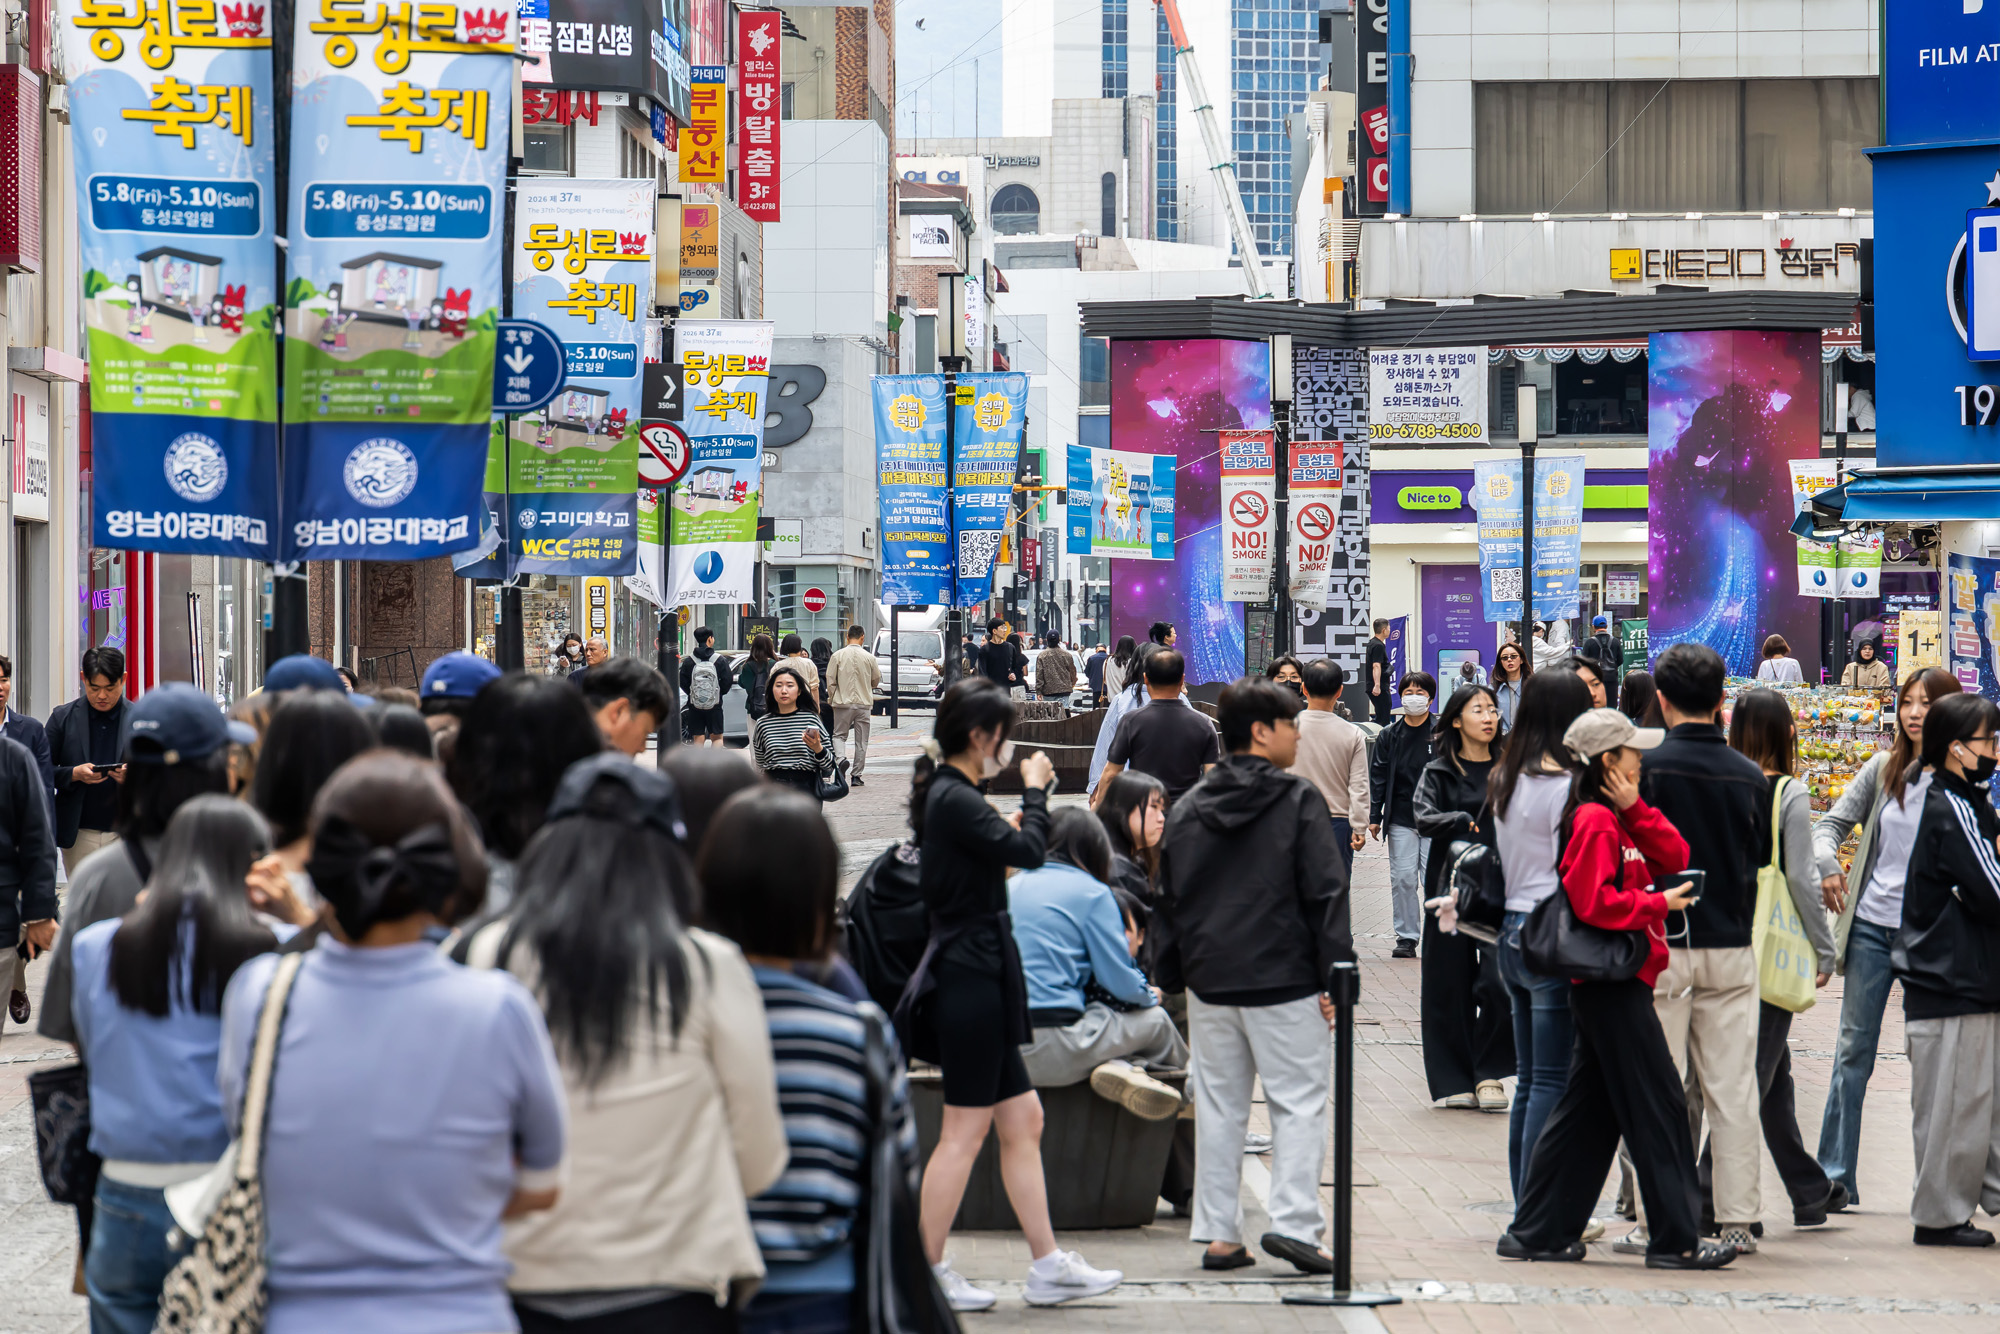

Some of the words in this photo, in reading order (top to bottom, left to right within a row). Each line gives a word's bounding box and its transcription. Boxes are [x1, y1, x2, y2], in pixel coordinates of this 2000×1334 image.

[556, 21, 593, 54] 점검
[597, 23, 633, 56] 신청
[1919, 46, 1968, 67] FILM
[745, 60, 775, 72] 앨리스
[690, 68, 724, 81] 카데미
[121, 75, 254, 149] 축제
[523, 90, 602, 126] 중개사
[346, 81, 490, 153] 축제
[687, 89, 721, 177] 부동산
[744, 83, 775, 177] 방탈출
[96, 181, 255, 210] 5.8(Fri)~5.10(Sun)
[749, 182, 771, 199] 3F
[312, 187, 486, 214] 5.8(Fri)~5.10(Sun)
[528, 195, 548, 203] 2026
[141, 209, 216, 229] 동성로일원
[355, 212, 437, 232] 동성로일원
[523, 223, 651, 274] 동성로
[680, 269, 716, 277] 25-0009
[547, 278, 637, 324] 축제
[697, 290, 706, 303] 2
[1371, 354, 1399, 365] 어려운
[1402, 354, 1422, 365] 경기
[1425, 354, 1435, 365] 속
[1438, 353, 1476, 365] 부담없이
[683, 350, 770, 387] 동성로
[1386, 368, 1426, 379] 장사하실
[1428, 368, 1438, 379] 수
[1441, 368, 1460, 379] 있게
[1394, 382, 1452, 394] 심해돈까스가
[658, 402, 677, 410] 350m
[694, 388, 758, 421] 축제
[896, 401, 920, 413] 전액
[982, 400, 1004, 412] 전액
[1383, 396, 1464, 408] 도와드리겠습니다.
[896, 415, 920, 428] 국비
[980, 414, 1003, 427] 국비
[1370, 424, 1482, 439] 010-6788-4500
[1229, 442, 1267, 456] 동성로
[1223, 456, 1273, 471] 금연거리
[1298, 454, 1335, 468] 동성로
[1292, 468, 1340, 482] 금연거리
[955, 493, 1011, 509] 부트캠프
[1407, 492, 1436, 503] Nice
[1438, 493, 1451, 503] to
[540, 511, 631, 528] 구미대학교
[105, 510, 269, 546] 영남이공대학교
[293, 512, 469, 547] 영남이공대학교
[522, 539, 571, 556] WCC
[572, 538, 601, 548] 교육부
[603, 538, 623, 549] 선정
[1232, 531, 1268, 549] NO!
[571, 549, 600, 560] 세계적
[602, 550, 622, 560] 대학
[1232, 550, 1267, 560] SMOKE
[1299, 544, 1331, 562] NO!
[1299, 562, 1327, 573] SMOKE
[680, 589, 739, 600] 한국가스공사
[1889, 595, 1913, 603] Smile
[1914, 595, 1931, 603] toy
